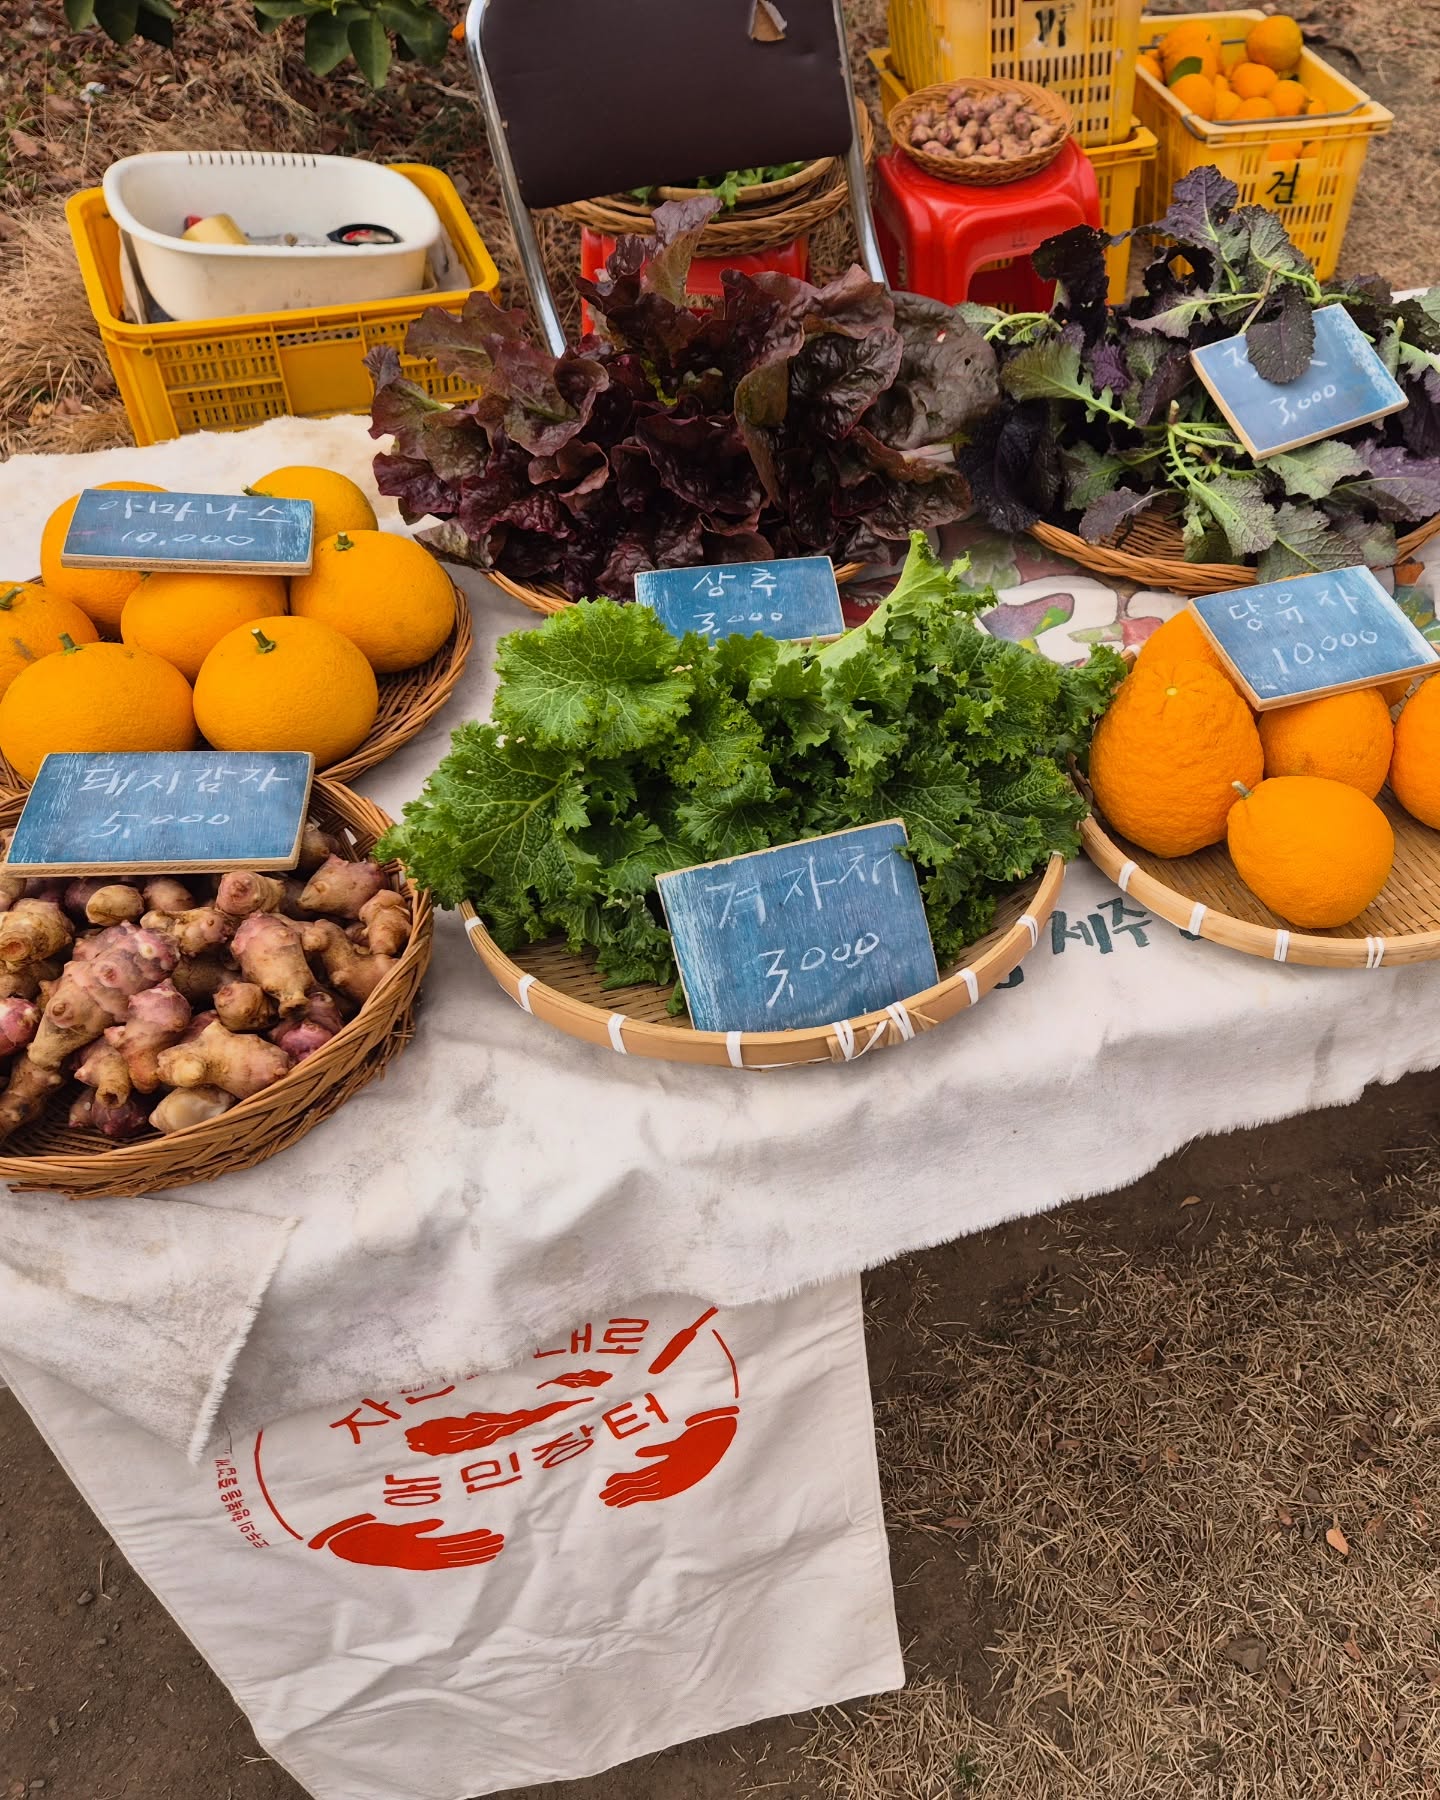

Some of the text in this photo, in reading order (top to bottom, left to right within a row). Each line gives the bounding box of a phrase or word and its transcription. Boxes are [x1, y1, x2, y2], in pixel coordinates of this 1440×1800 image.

[98, 498, 293, 522] 아마나스
[1229, 581, 1360, 631] 당유자
[1271, 630, 1379, 675] 10,000
[77, 765, 291, 797] 돼지감자
[759, 931, 881, 1009] 3,000
[382, 1392, 669, 1507] 농민장터
[220, 1488, 251, 1523] 행복을
